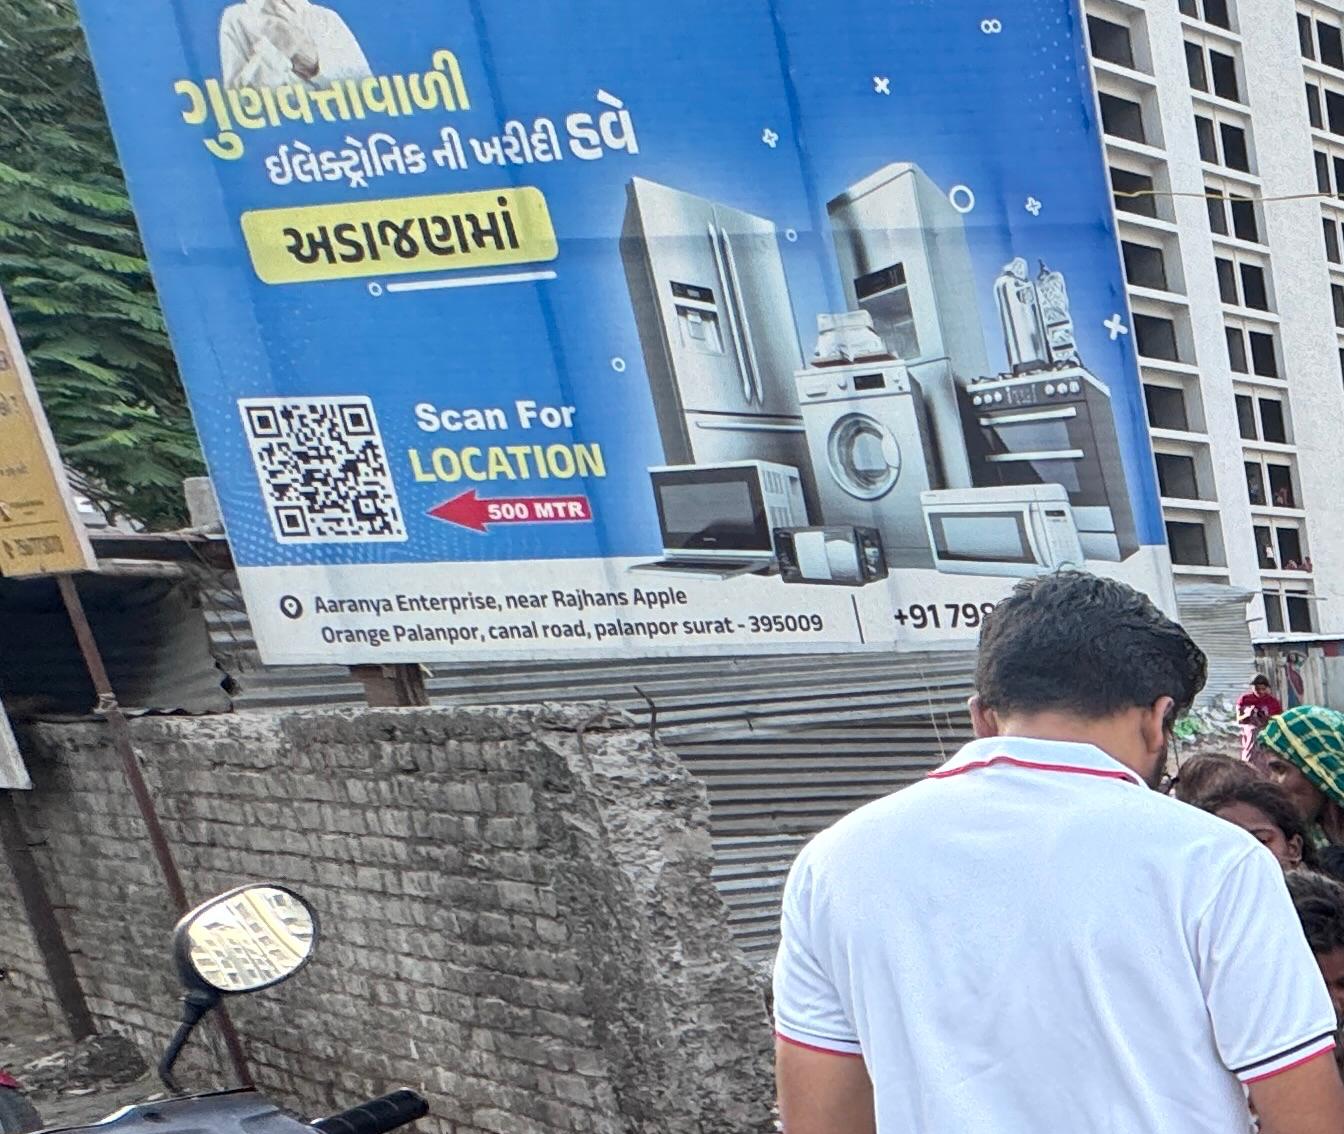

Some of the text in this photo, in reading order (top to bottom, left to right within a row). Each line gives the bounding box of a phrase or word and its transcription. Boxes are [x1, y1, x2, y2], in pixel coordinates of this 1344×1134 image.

[174, 50, 470, 160] ગુણવત્તાવાળી
[432, 127, 468, 170] ની
[469, 118, 563, 165] ખરીદી
[566, 88, 639, 160] હવે
[283, 196, 520, 265] અડાજણમાં
[414, 400, 576, 432] Scan For
[408, 443, 607, 483] LOCATION
[488, 501, 585, 520] 500 MTR
[314, 586, 688, 617] Aaranya Enterprise, near Rajhans Apple
[894, 603, 941, 629] +91
[321, 626, 391, 647] Orange
[393, 623, 486, 645] Palanpor,
[488, 621, 539, 640] canal
[542, 618, 592, 640] road,
[594, 617, 679, 641] palanpor
[682, 616, 735, 635] surat
[748, 613, 825, 634] 395009
